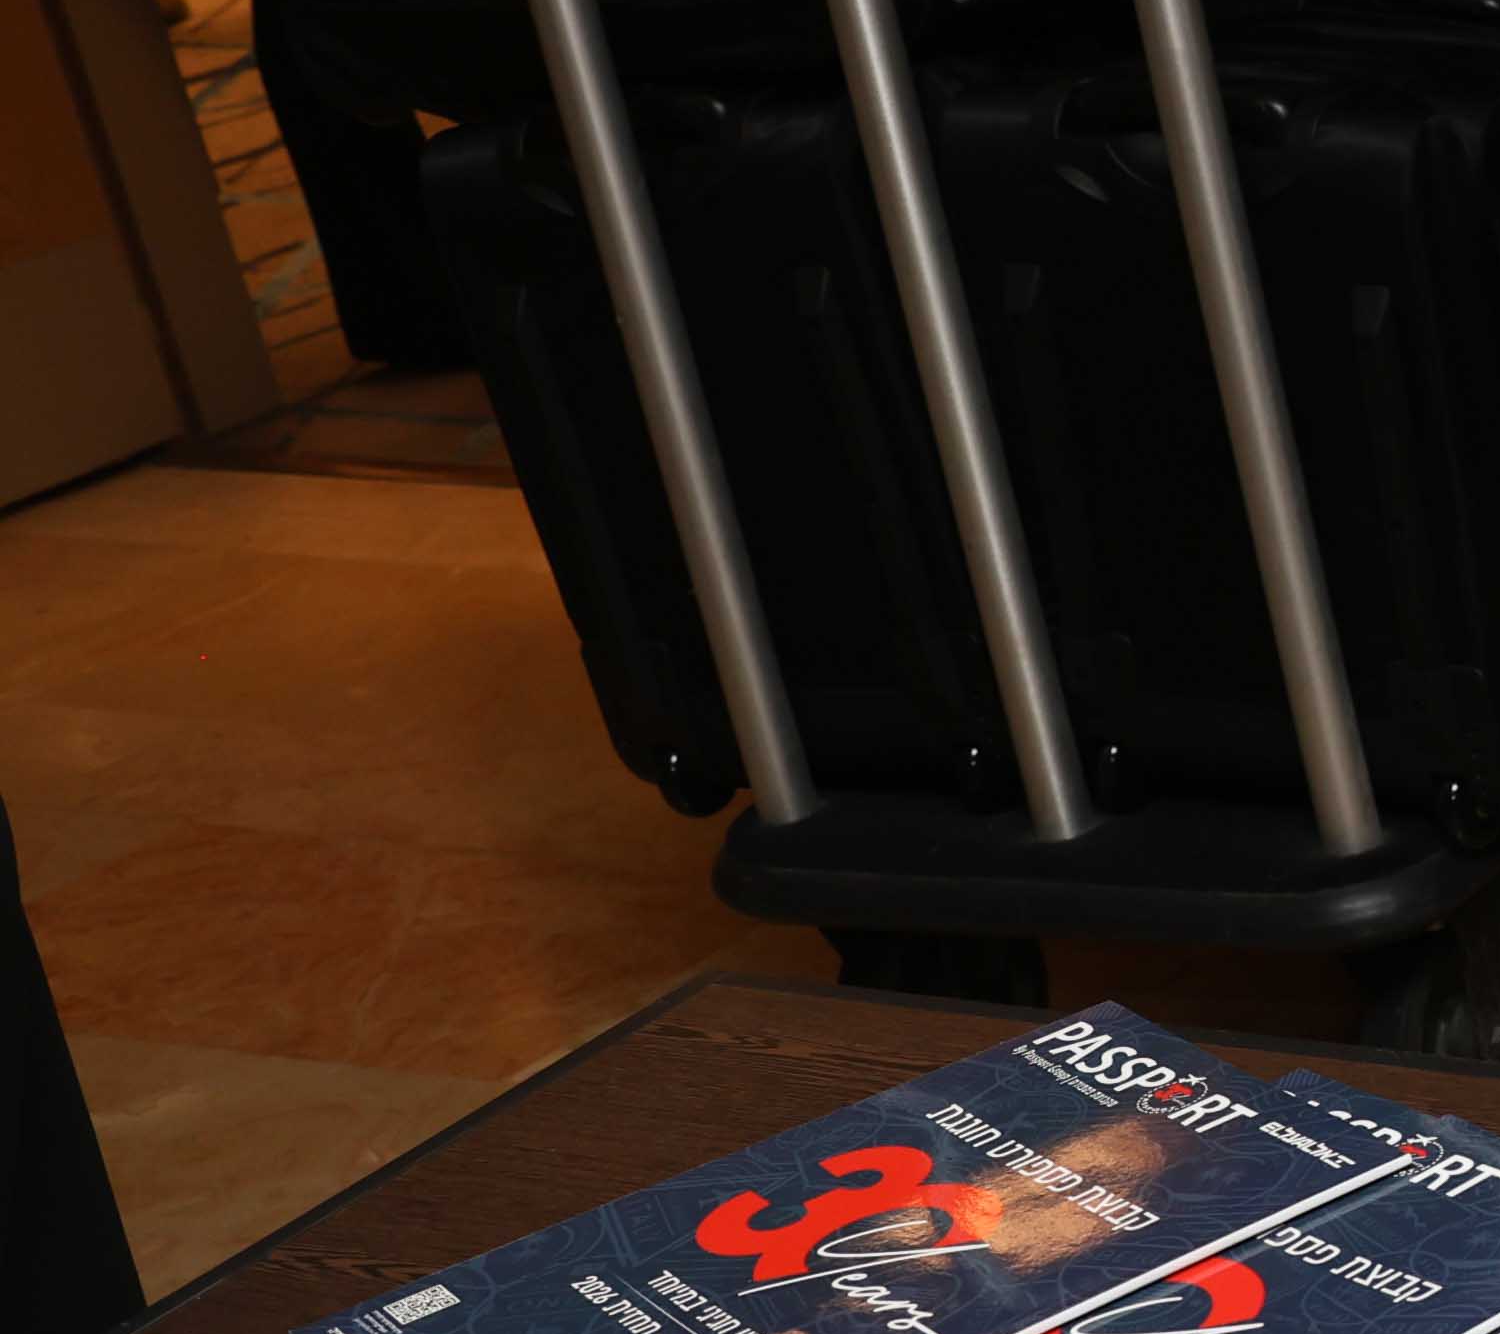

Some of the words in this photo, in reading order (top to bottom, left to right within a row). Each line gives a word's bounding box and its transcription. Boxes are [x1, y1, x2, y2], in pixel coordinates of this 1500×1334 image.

[1033, 1021, 1258, 1133] PASSPORT
[926, 1103, 1001, 1149] חוגגת
[987, 1133, 1083, 1195] פספורט
[1067, 1186, 1160, 1234] קבוצת
[572, 1275, 616, 1308] 2026
[648, 1270, 707, 1315] במיוחד
[1332, 1256, 1443, 1305] קבוצת
[698, 1305, 737, 1333] חגיגי
